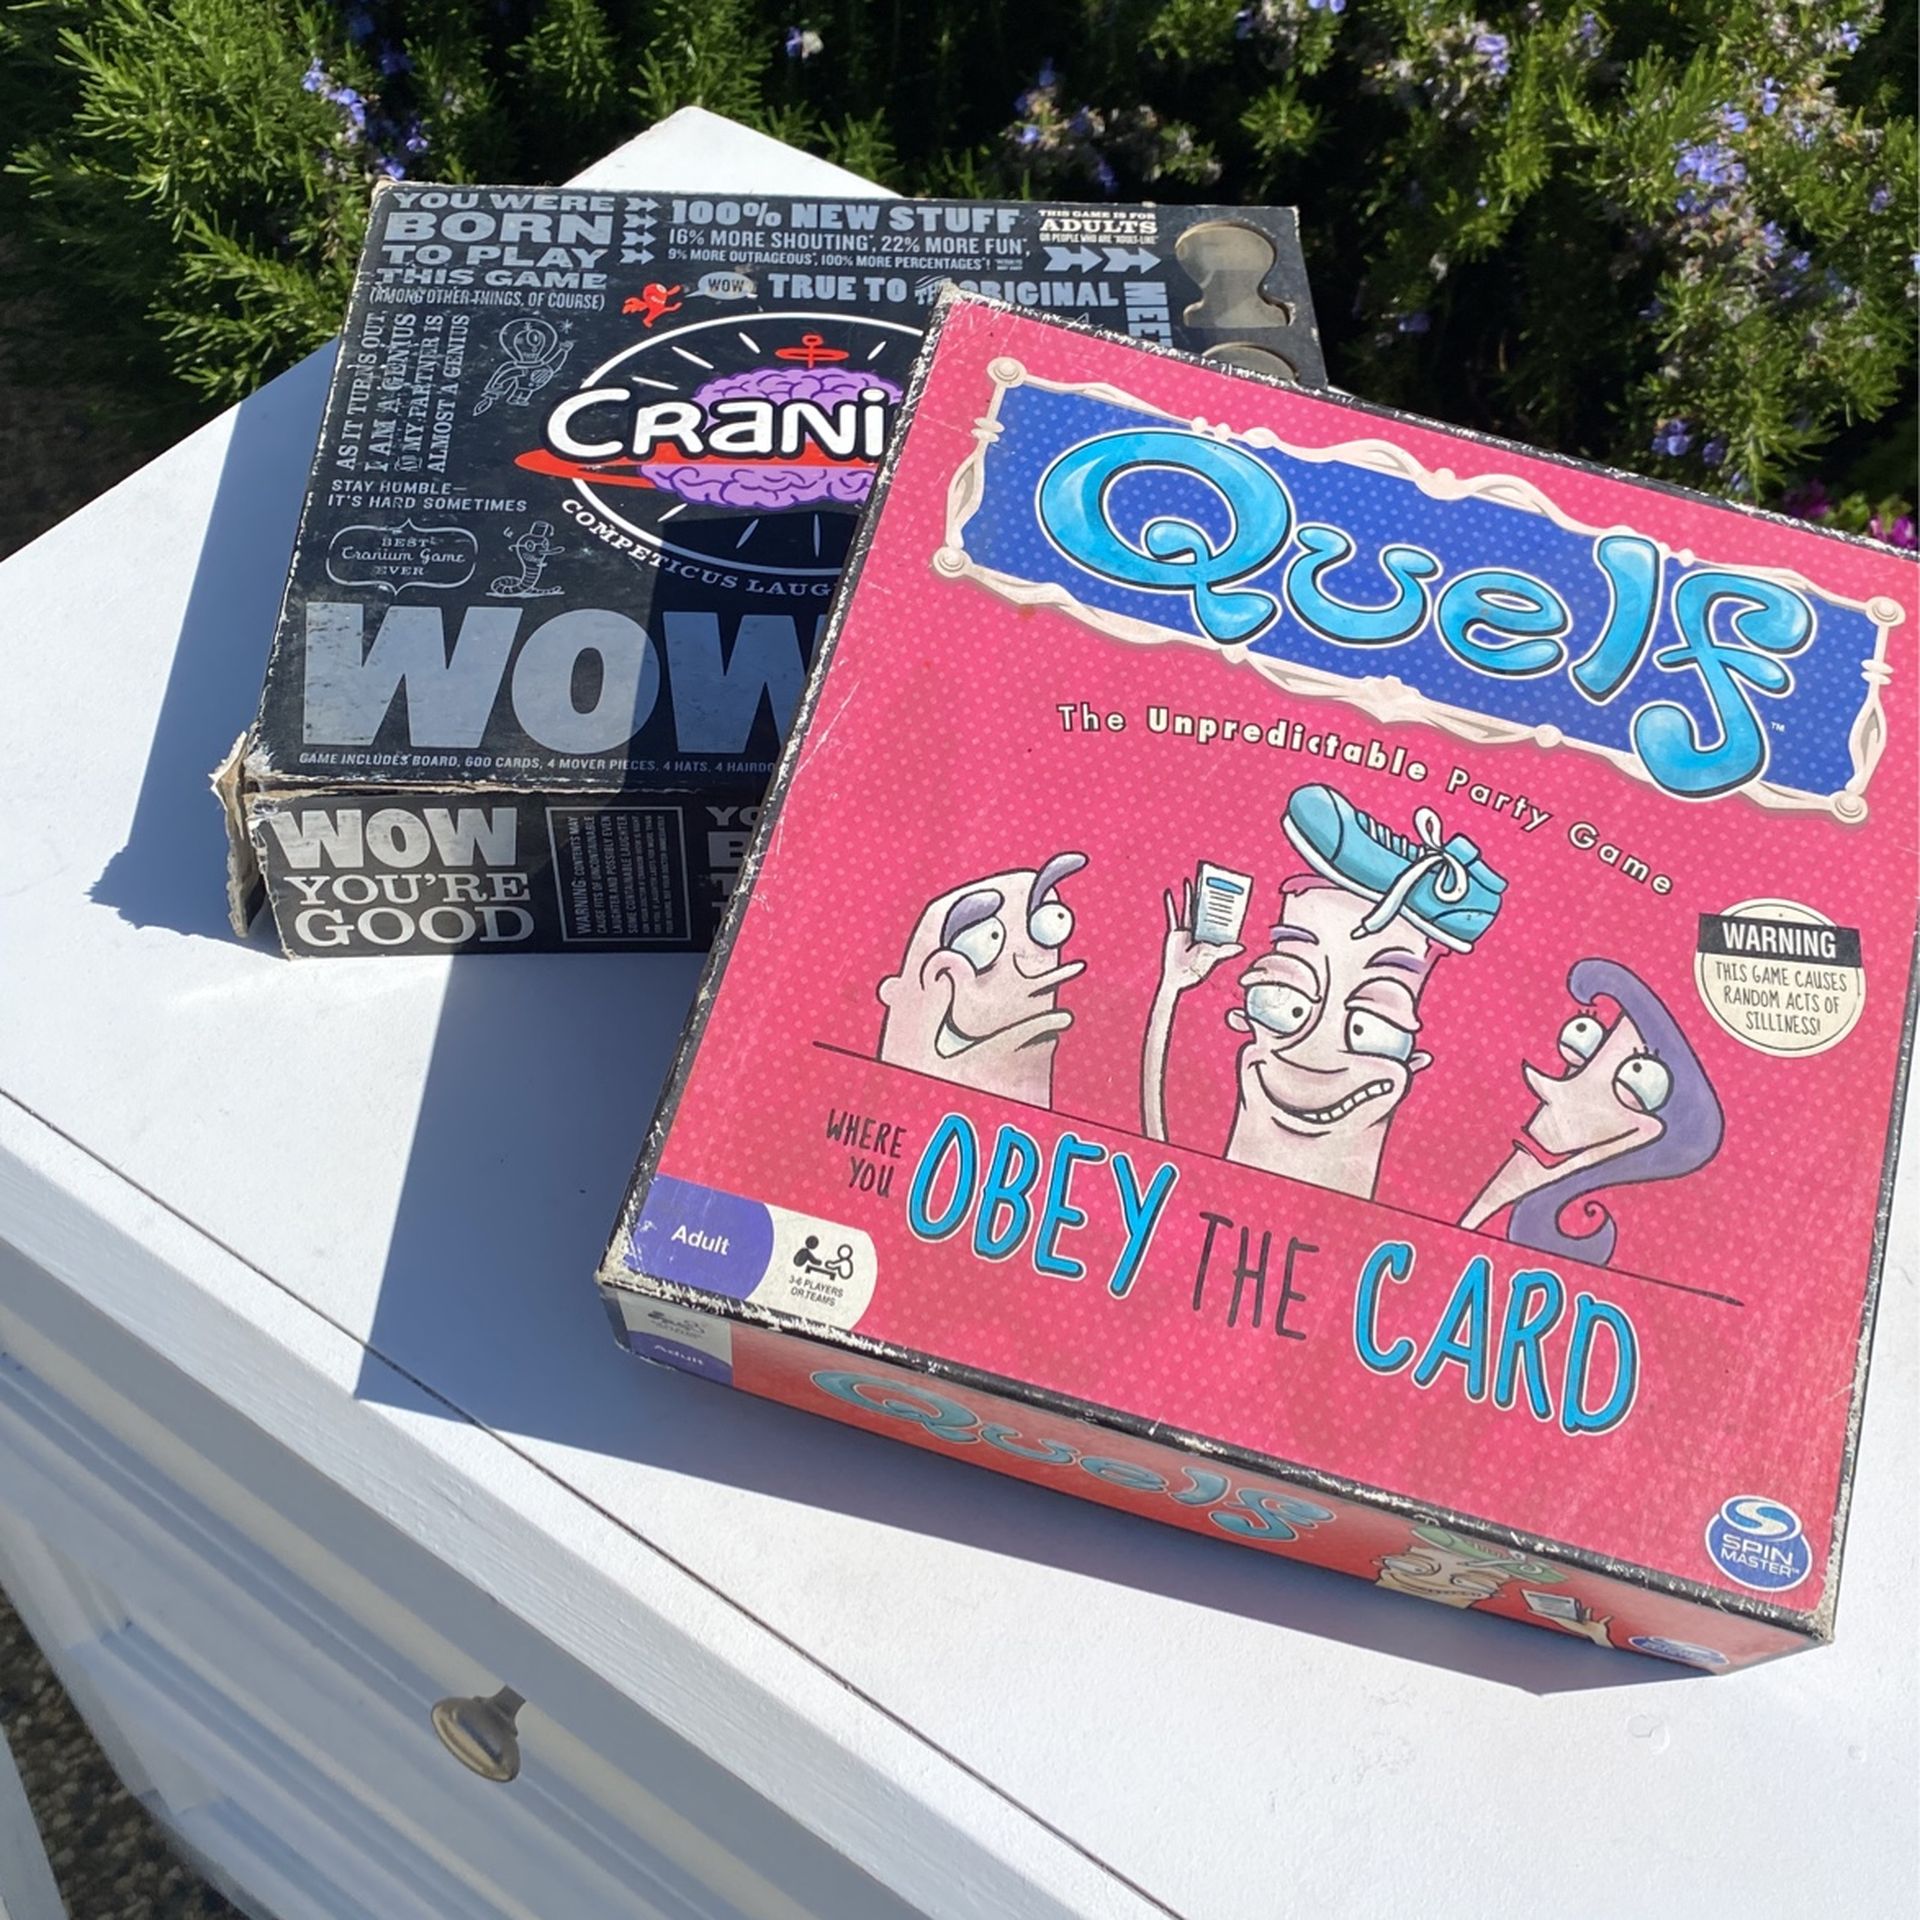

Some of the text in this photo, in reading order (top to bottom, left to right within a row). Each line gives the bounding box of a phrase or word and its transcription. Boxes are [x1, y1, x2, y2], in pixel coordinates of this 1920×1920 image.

[393, 193, 615, 211] YOU WERE
[672, 200, 1020, 233] 100% NEW STUFF
[1038, 209, 1156, 220] THIS GAME IS FOR
[384, 211, 613, 244] BORN
[1039, 218, 1158, 234] ADULTS
[669, 228, 705, 245] 16%
[710, 230, 765, 248] MORE
[881, 236, 920, 253] 22%
[925, 237, 979, 254] MORE
[382, 244, 608, 268] TO PLAY
[668, 248, 687, 260] 9%
[690, 249, 726, 261] MORE
[821, 254, 853, 266] 100%
[856, 255, 891, 268] MORE
[376, 267, 607, 290] THIS GAME
[708, 277, 745, 293] WOW
[768, 273, 856, 300] TRUE
[863, 277, 907, 302] TO
[369, 286, 425, 305] (AMONG
[426, 288, 470, 306] OTHER
[529, 291, 545, 307] OF
[547, 292, 606, 310] COURSE)
[423, 315, 444, 332] IS
[1124, 282, 1173, 347] MEE
[381, 313, 417, 391] GENIUS
[347, 353, 377, 415] TURNS
[408, 337, 440, 417] PARTNER
[377, 396, 400, 413] A
[427, 314, 470, 473] ALMOST A GENIUS
[341, 420, 363, 440] IT
[368, 419, 396, 457] AM
[402, 422, 424, 452] MY
[336, 444, 359, 471] AS
[331, 479, 374, 492] STAY
[328, 493, 527, 512] IT'S HARD SOMETIMES
[341, 546, 466, 565] Cranium Game
[381, 536, 428, 548] BEST
[562, 499, 836, 597] COMPETICUS LAUG
[375, 566, 425, 576] EVER
[1036, 427, 1816, 799] Quelf
[304, 602, 826, 755] WOW
[299, 752, 337, 764] GAME
[341, 753, 409, 766] INCLUDES
[465, 755, 491, 767] 600
[495, 756, 543, 770] CARDS,
[547, 758, 555, 768] 4
[559, 758, 605, 770] MOVER
[663, 761, 670, 771] 4
[715, 762, 723, 772] 4
[727, 762, 775, 773] HAIRDO
[1057, 702, 1673, 896] The Unpredictable Party Game
[270, 807, 517, 868] WOW
[568, 816, 580, 835] MAY
[285, 872, 531, 904] YOU'RE
[294, 907, 535, 947] GOOD
[1722, 922, 1837, 959] WARNING
[1715, 961, 1848, 992] THIS GAME CAUSES
[1724, 985, 1840, 1014] RANDOM ACTS OF
[1746, 1011, 1821, 1036] SILLINESS!
[827, 1108, 907, 1159] WHERE
[848, 1156, 895, 1199] YOU
[671, 1225, 730, 1255] Adult
[804, 1278, 844, 1298] PLAYERS
[907, 1112, 1639, 1436] OBEY THE CARD
[790, 1286, 836, 1307] OR TEAMS
[810, 1369, 1336, 1541] Quelf
[1722, 1533, 1793, 1566] SPIN
